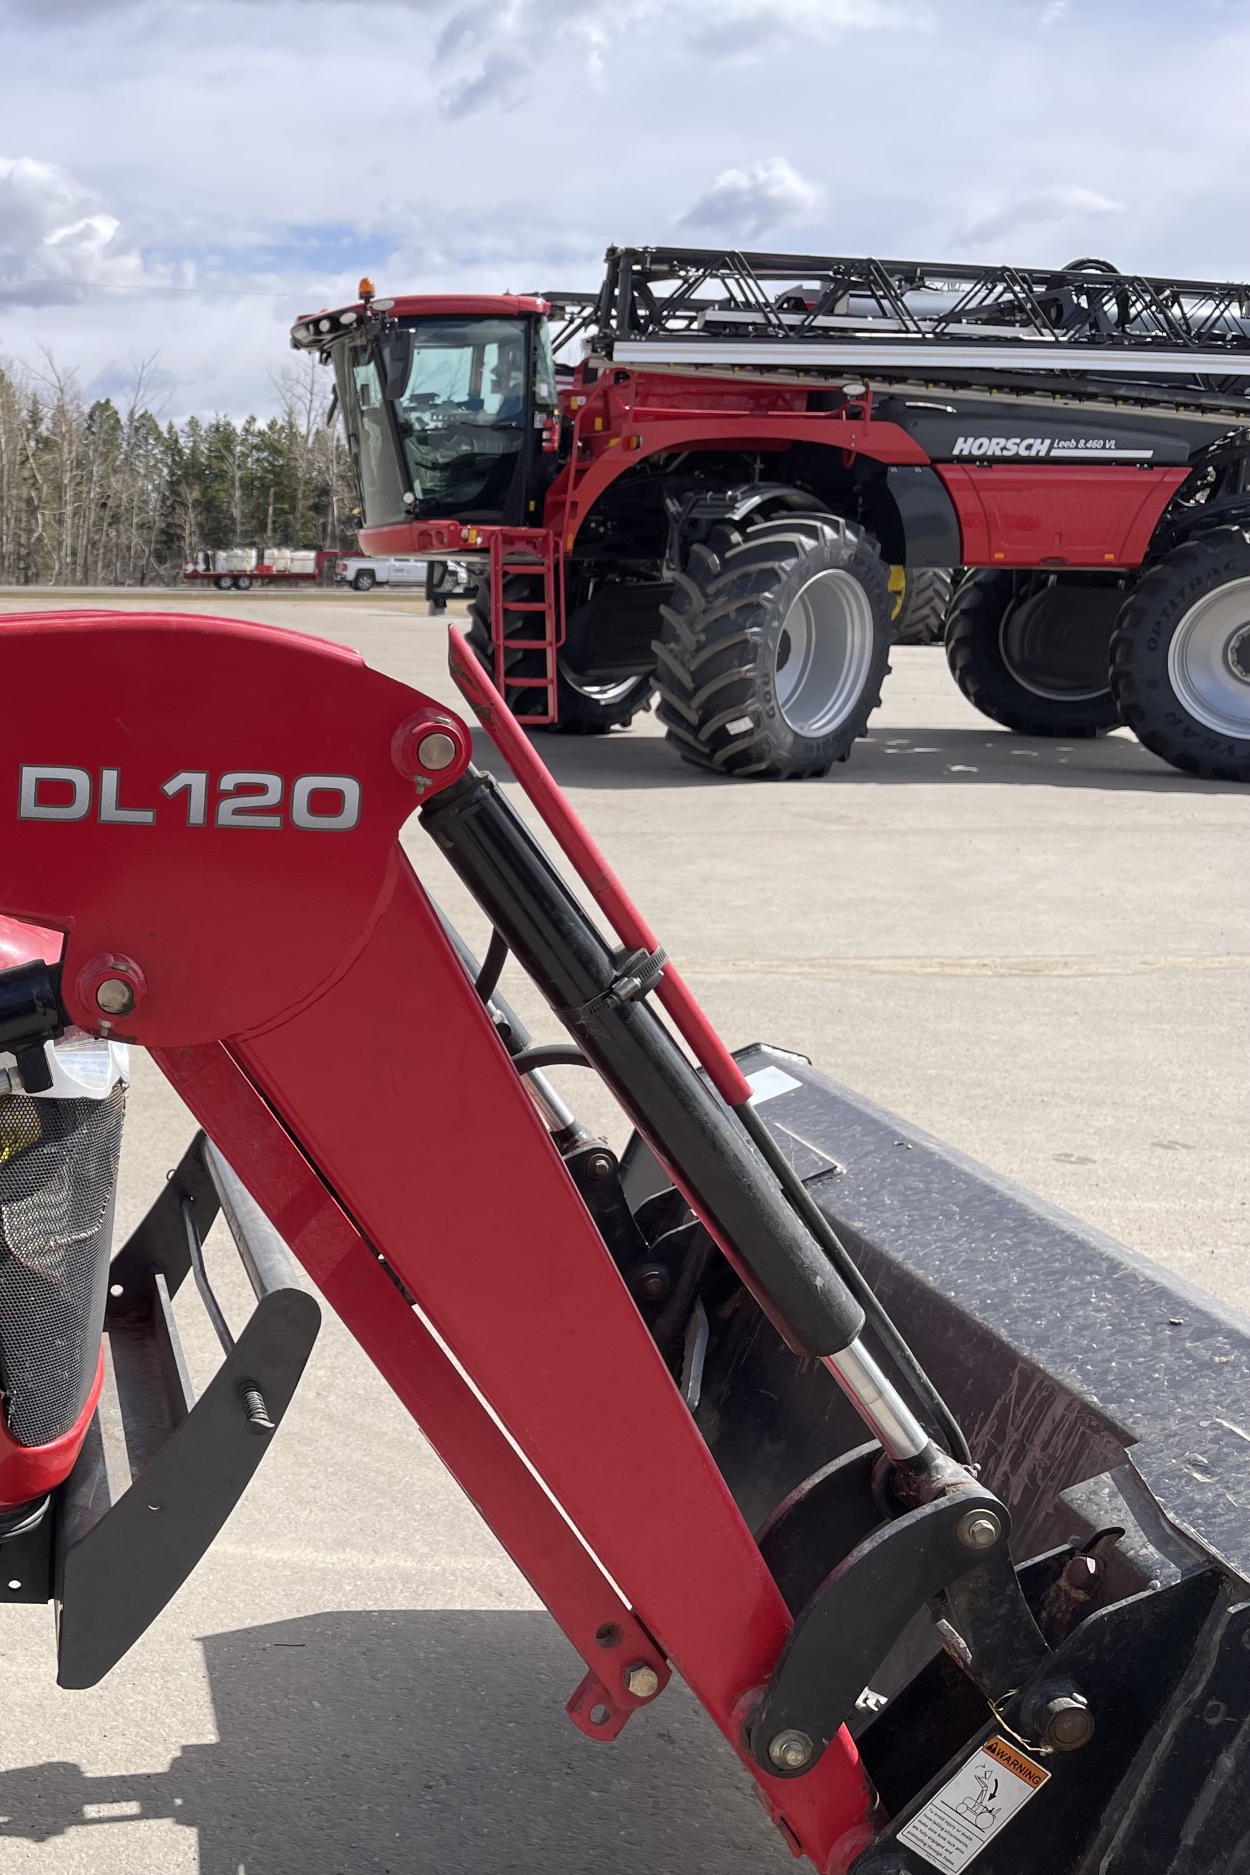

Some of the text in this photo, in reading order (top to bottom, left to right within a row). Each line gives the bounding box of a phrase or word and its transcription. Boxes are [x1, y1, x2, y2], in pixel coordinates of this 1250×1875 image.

[951, 436, 1051, 457] HORSCH
[1053, 438, 1076, 448] Leeb
[1105, 439, 1117, 449] VL
[996, 1748, 1042, 1785] WARNING
[928, 1836, 946, 1849] engaged
[961, 1832, 973, 1841] death
